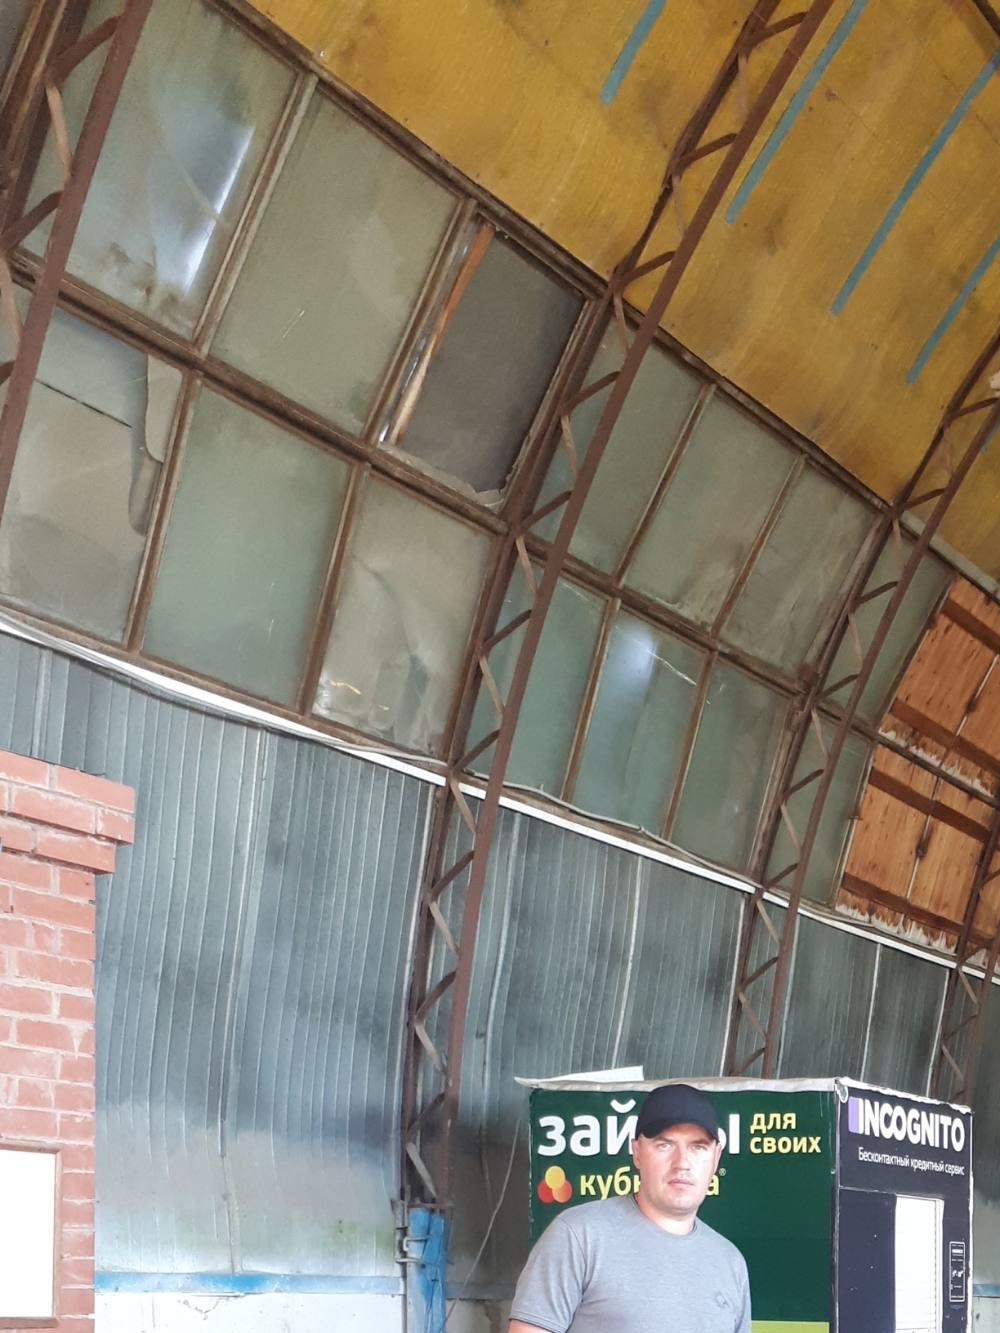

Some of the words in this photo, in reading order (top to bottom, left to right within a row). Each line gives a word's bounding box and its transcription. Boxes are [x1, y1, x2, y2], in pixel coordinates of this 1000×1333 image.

[537, 1098, 741, 1157] зайы
[750, 1112, 797, 1134] для
[858, 1097, 966, 1152] INCOGNITO
[750, 1133, 822, 1154] своих
[858, 1146, 910, 1168] Бесконтактный
[910, 1157, 945, 1172] кредитный
[944, 1163, 965, 1176] сервис
[579, 1165, 720, 1200] куба
